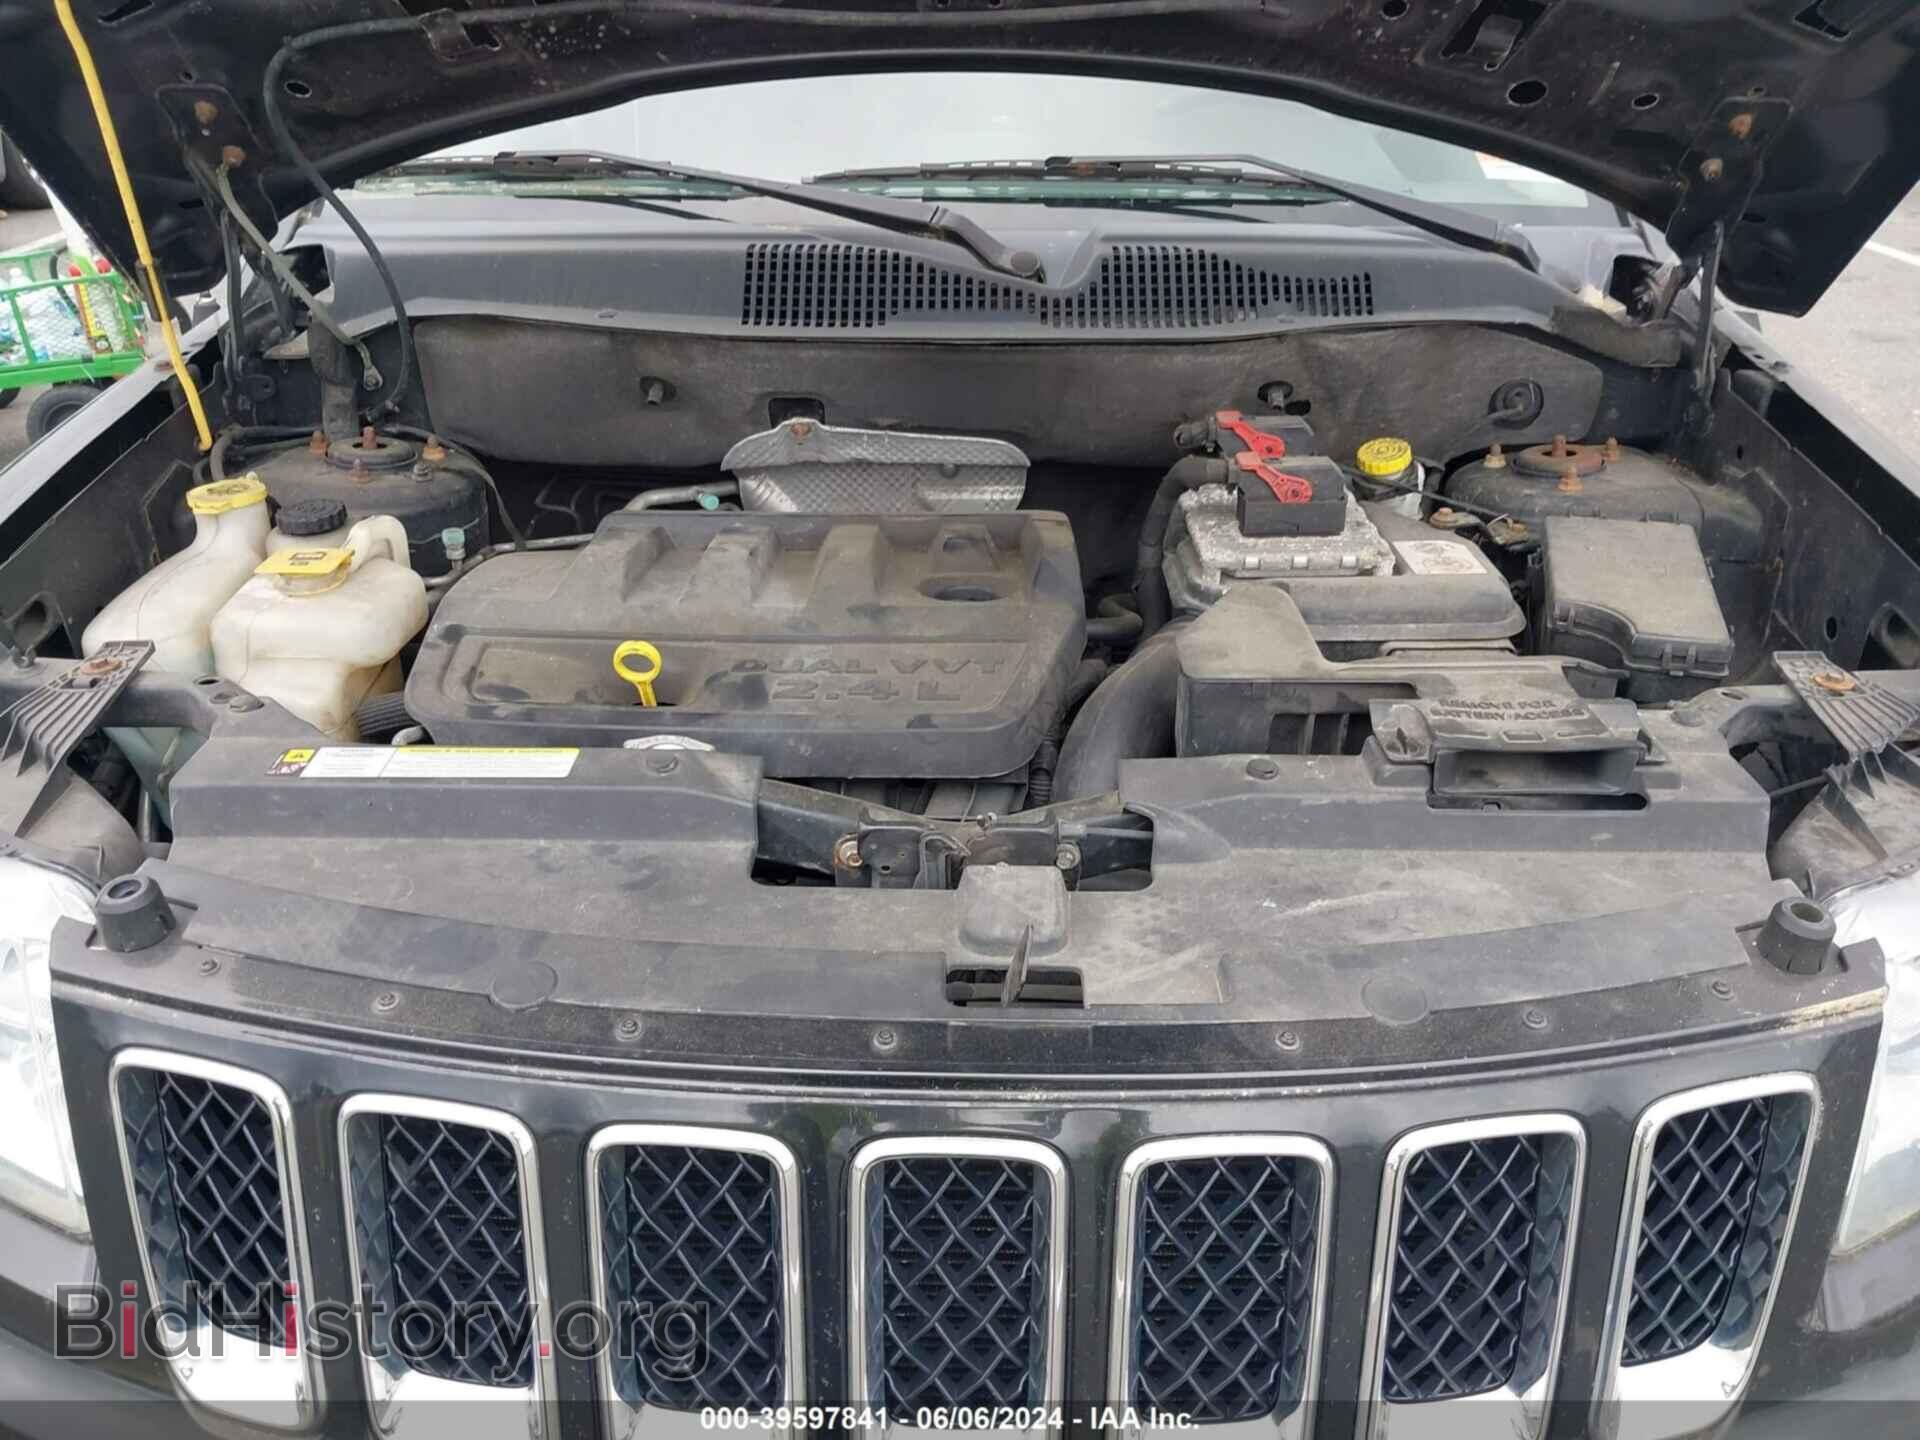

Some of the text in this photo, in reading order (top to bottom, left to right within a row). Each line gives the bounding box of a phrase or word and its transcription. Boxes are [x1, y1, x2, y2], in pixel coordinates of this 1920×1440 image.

[731, 657, 1007, 675] DUAL VVT
[771, 679, 900, 702] 2.4
[1439, 699, 1513, 711] REMOVE
